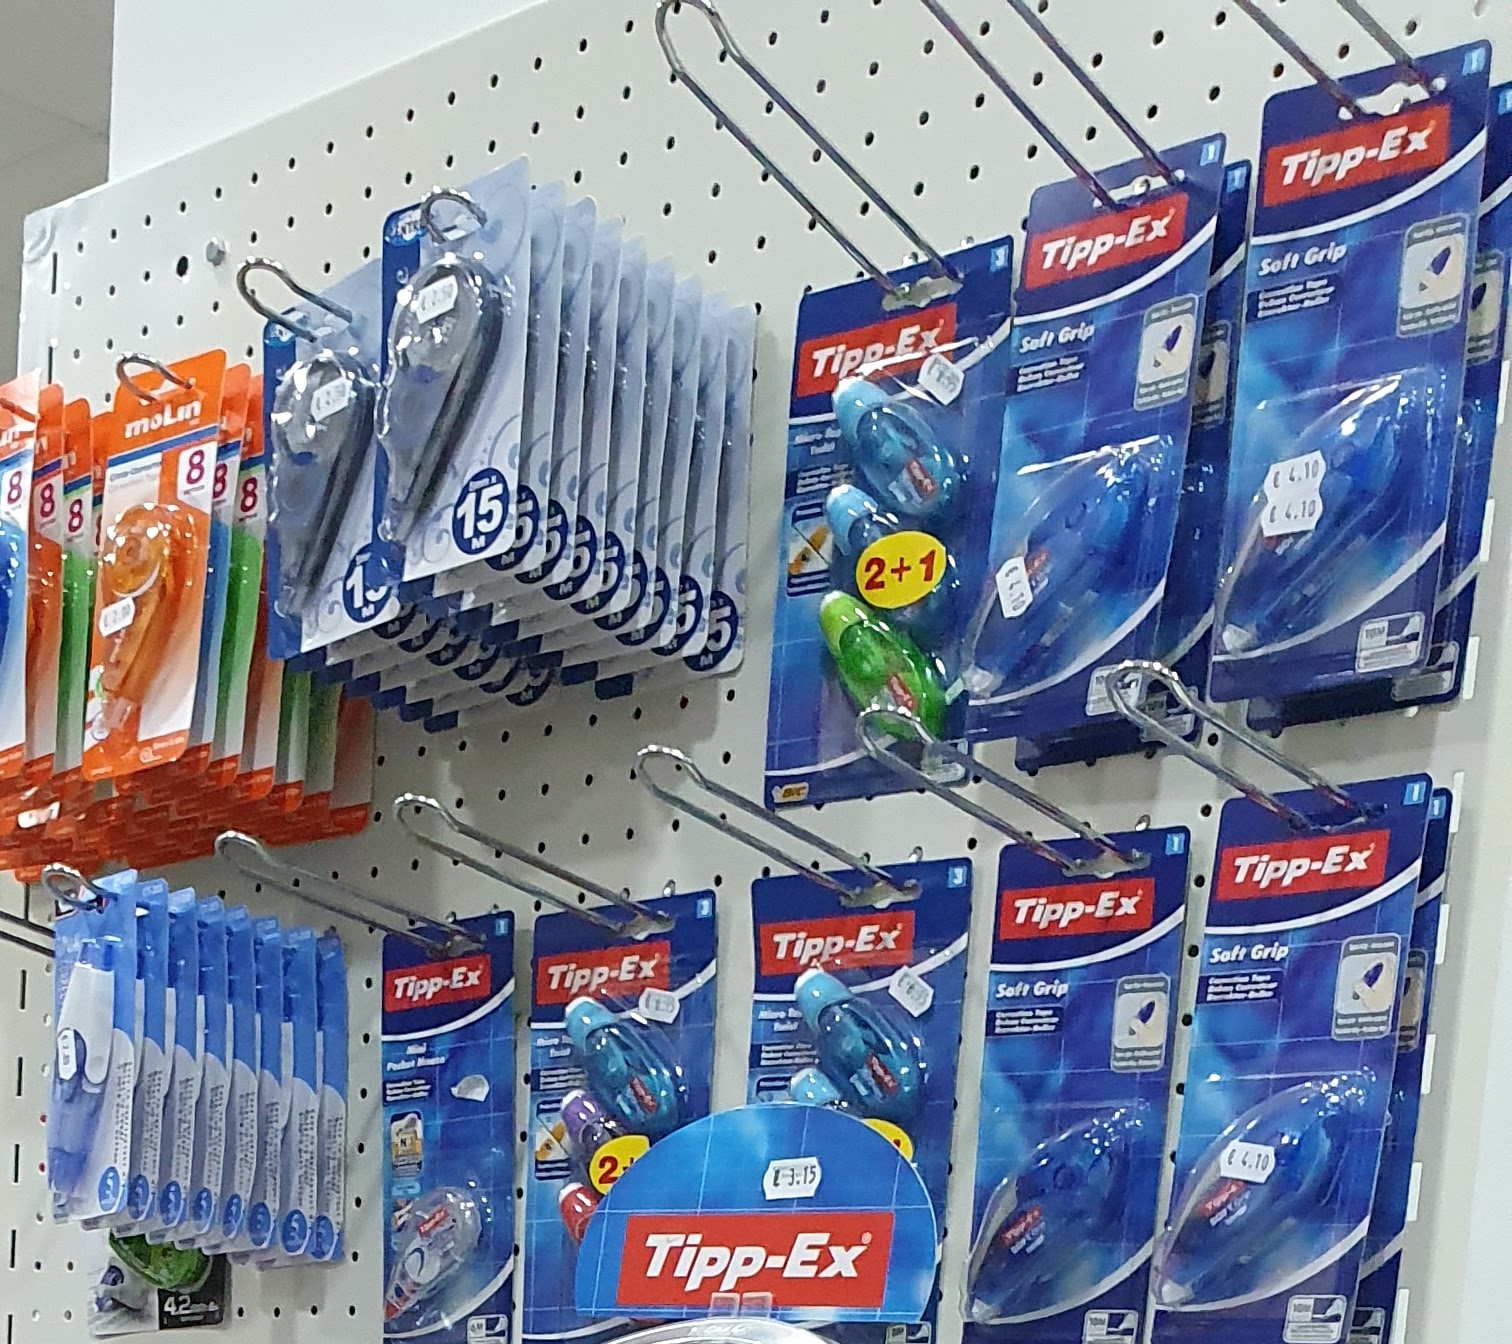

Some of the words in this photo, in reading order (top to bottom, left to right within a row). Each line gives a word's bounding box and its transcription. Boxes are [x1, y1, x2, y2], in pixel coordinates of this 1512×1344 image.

[1282, 122, 1436, 187] Tipp-Ex
[1042, 212, 1175, 270] Tipp-Ex
[1258, 253, 1299, 276] Soft
[1304, 242, 1347, 264] Grip
[1020, 330, 1053, 353] Soft
[1059, 322, 1095, 343] Grip
[188, 450, 205, 484] 8
[212, 463, 227, 498] 8
[1287, 459, 1321, 482] 4.10
[7, 471, 23, 505] 8
[40, 483, 55, 518] 8
[240, 477, 258, 512] 8
[68, 499, 84, 533] 8
[455, 490, 504, 541] 15
[1284, 499, 1317, 519] 4.10
[470, 536, 486, 551] M
[864, 549, 937, 592] 2+1
[1234, 843, 1376, 887] Tipp-Ex
[1013, 890, 1141, 930] Tipp-Ex
[772, 922, 901, 965] Tipp-Ex
[1209, 944, 1245, 964] Soft
[1250, 942, 1289, 962] Grip
[392, 965, 482, 1001] Tipp-Ex
[547, 954, 659, 993] Tipp-Ex
[995, 981, 1030, 1000] Soft
[1033, 979, 1069, 998] Grip
[1239, 1150, 1270, 1172] 4.10
[643, 1228, 872, 1292] Tipp-Ex
